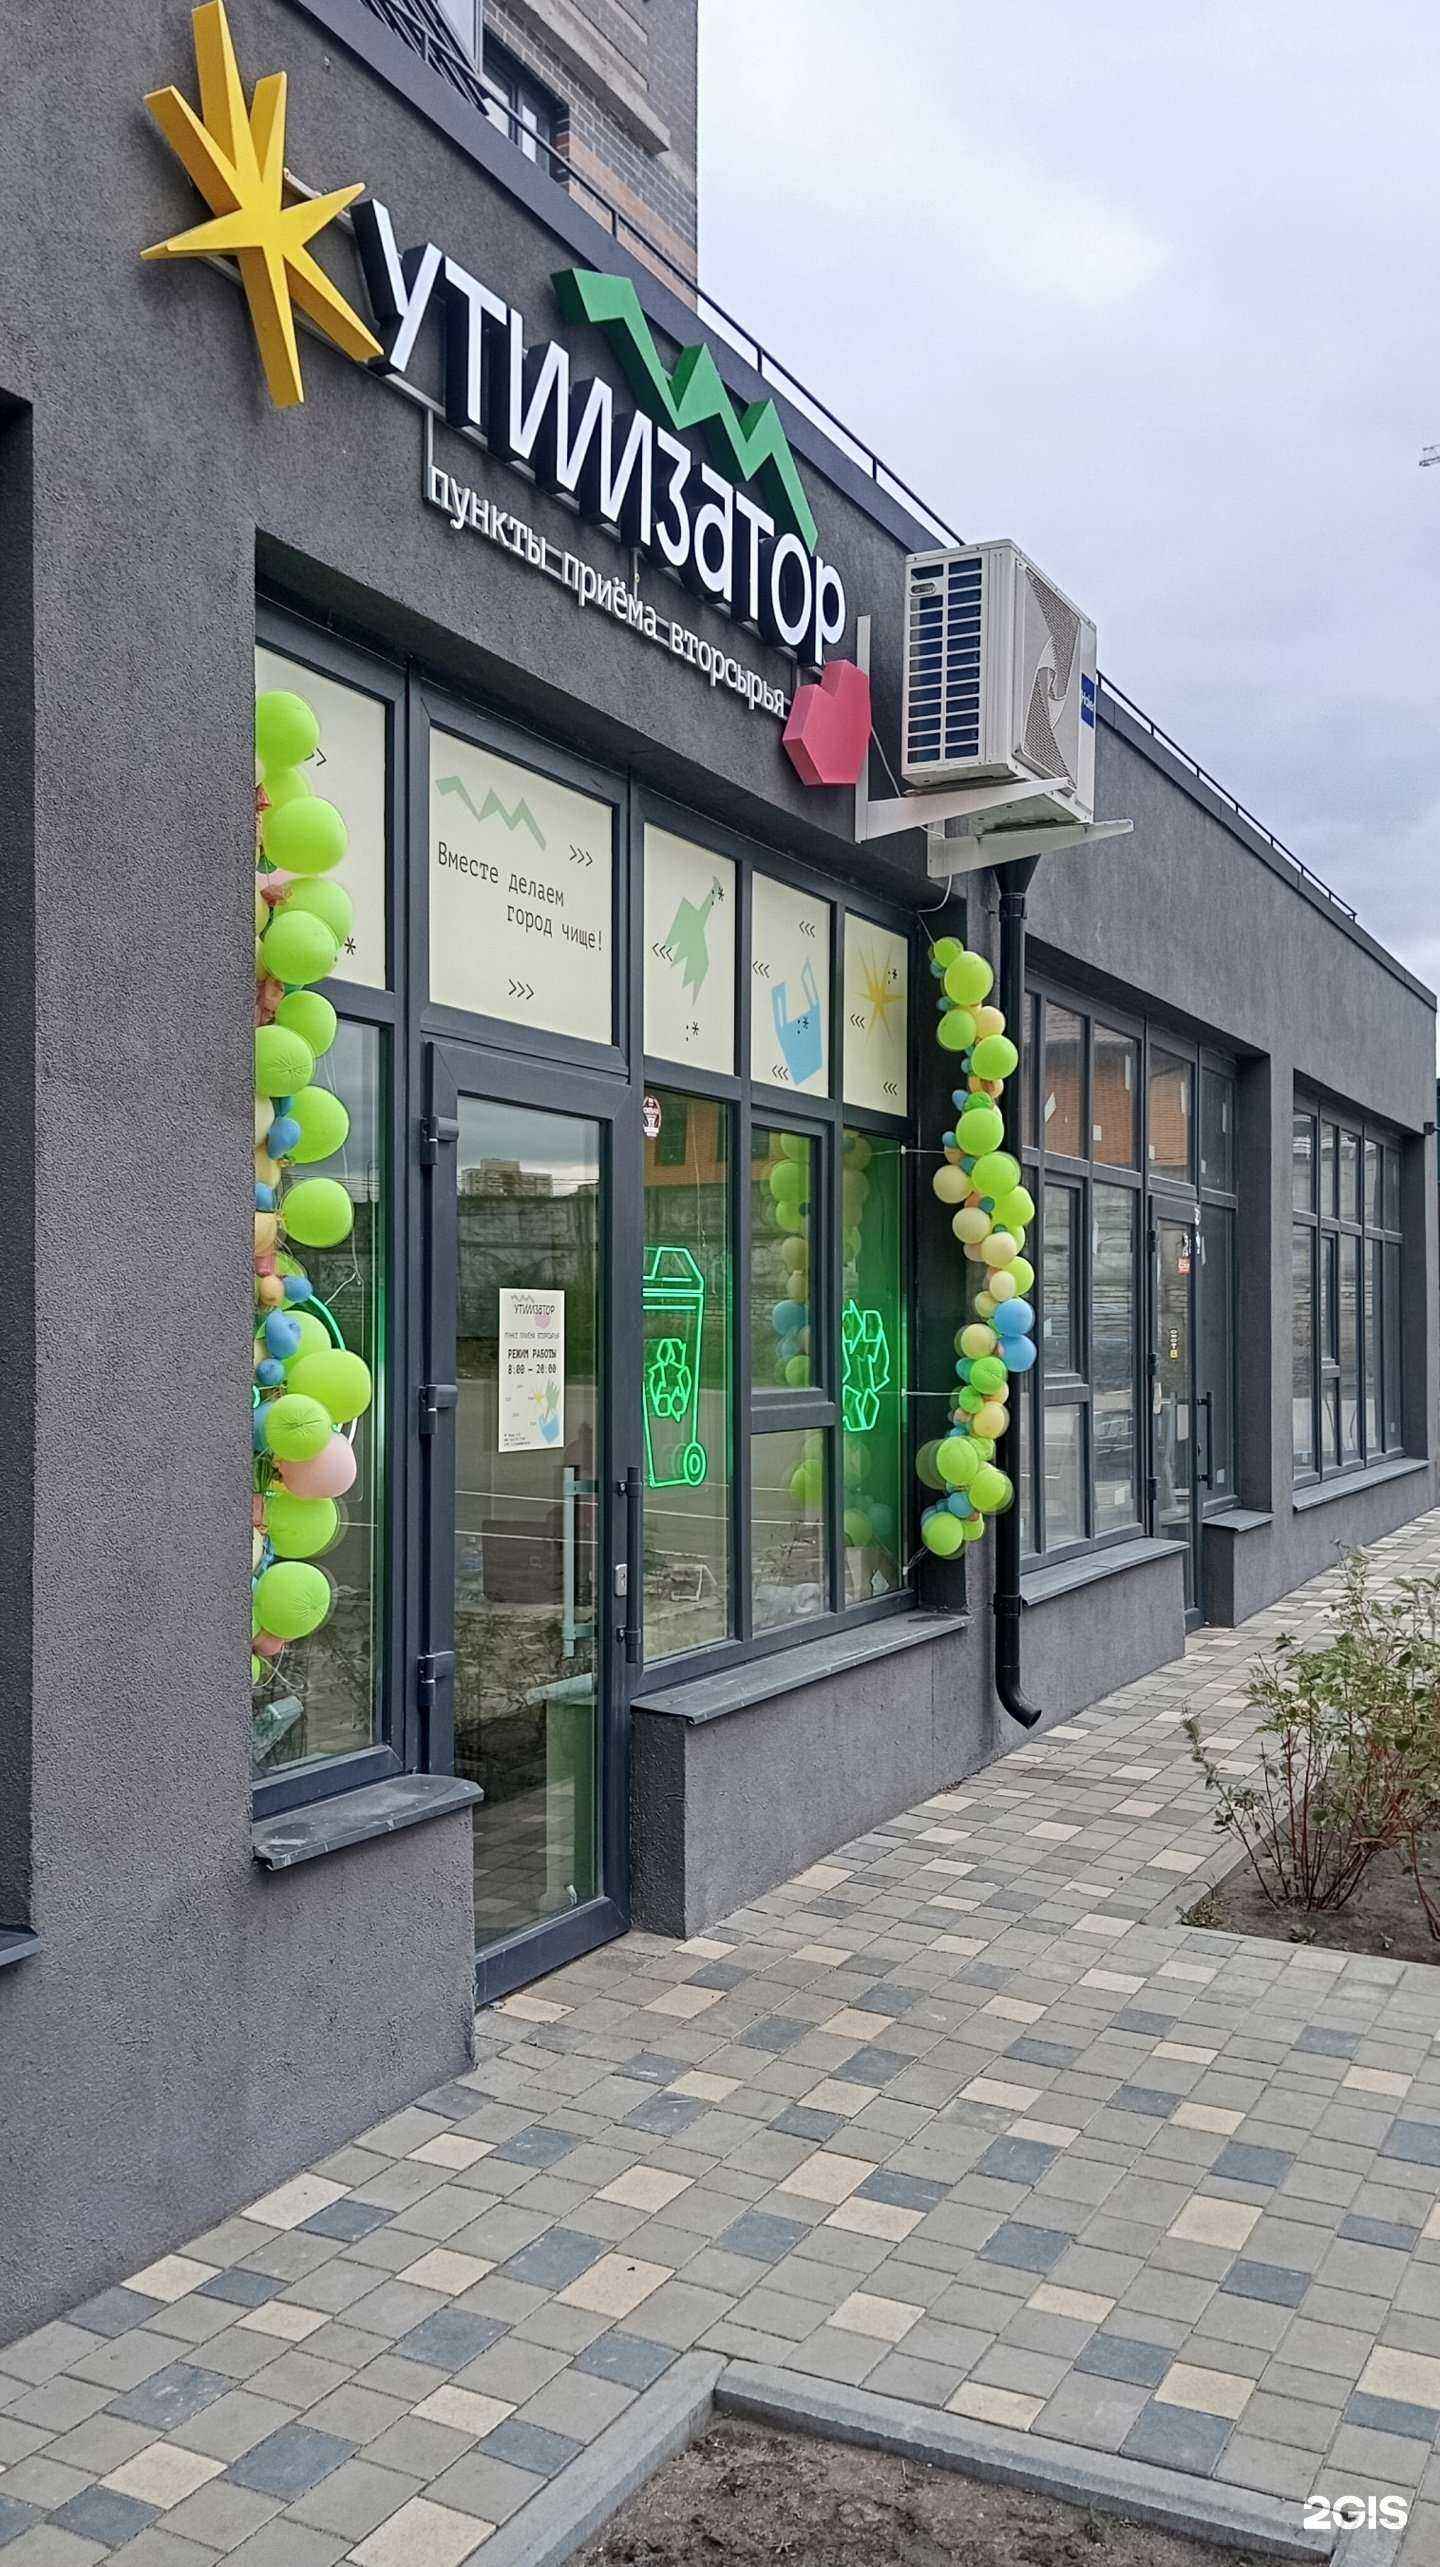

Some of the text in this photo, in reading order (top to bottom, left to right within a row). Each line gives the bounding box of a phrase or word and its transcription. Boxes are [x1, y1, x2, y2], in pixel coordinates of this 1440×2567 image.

[430, 465, 785, 718] пункты приёма вторсырья
[438, 841, 564, 907] Вместе делаем
[507, 904, 602, 951] город чище!
[508, 1348, 557, 1360] РЕЖИМ РАБОТЫ
